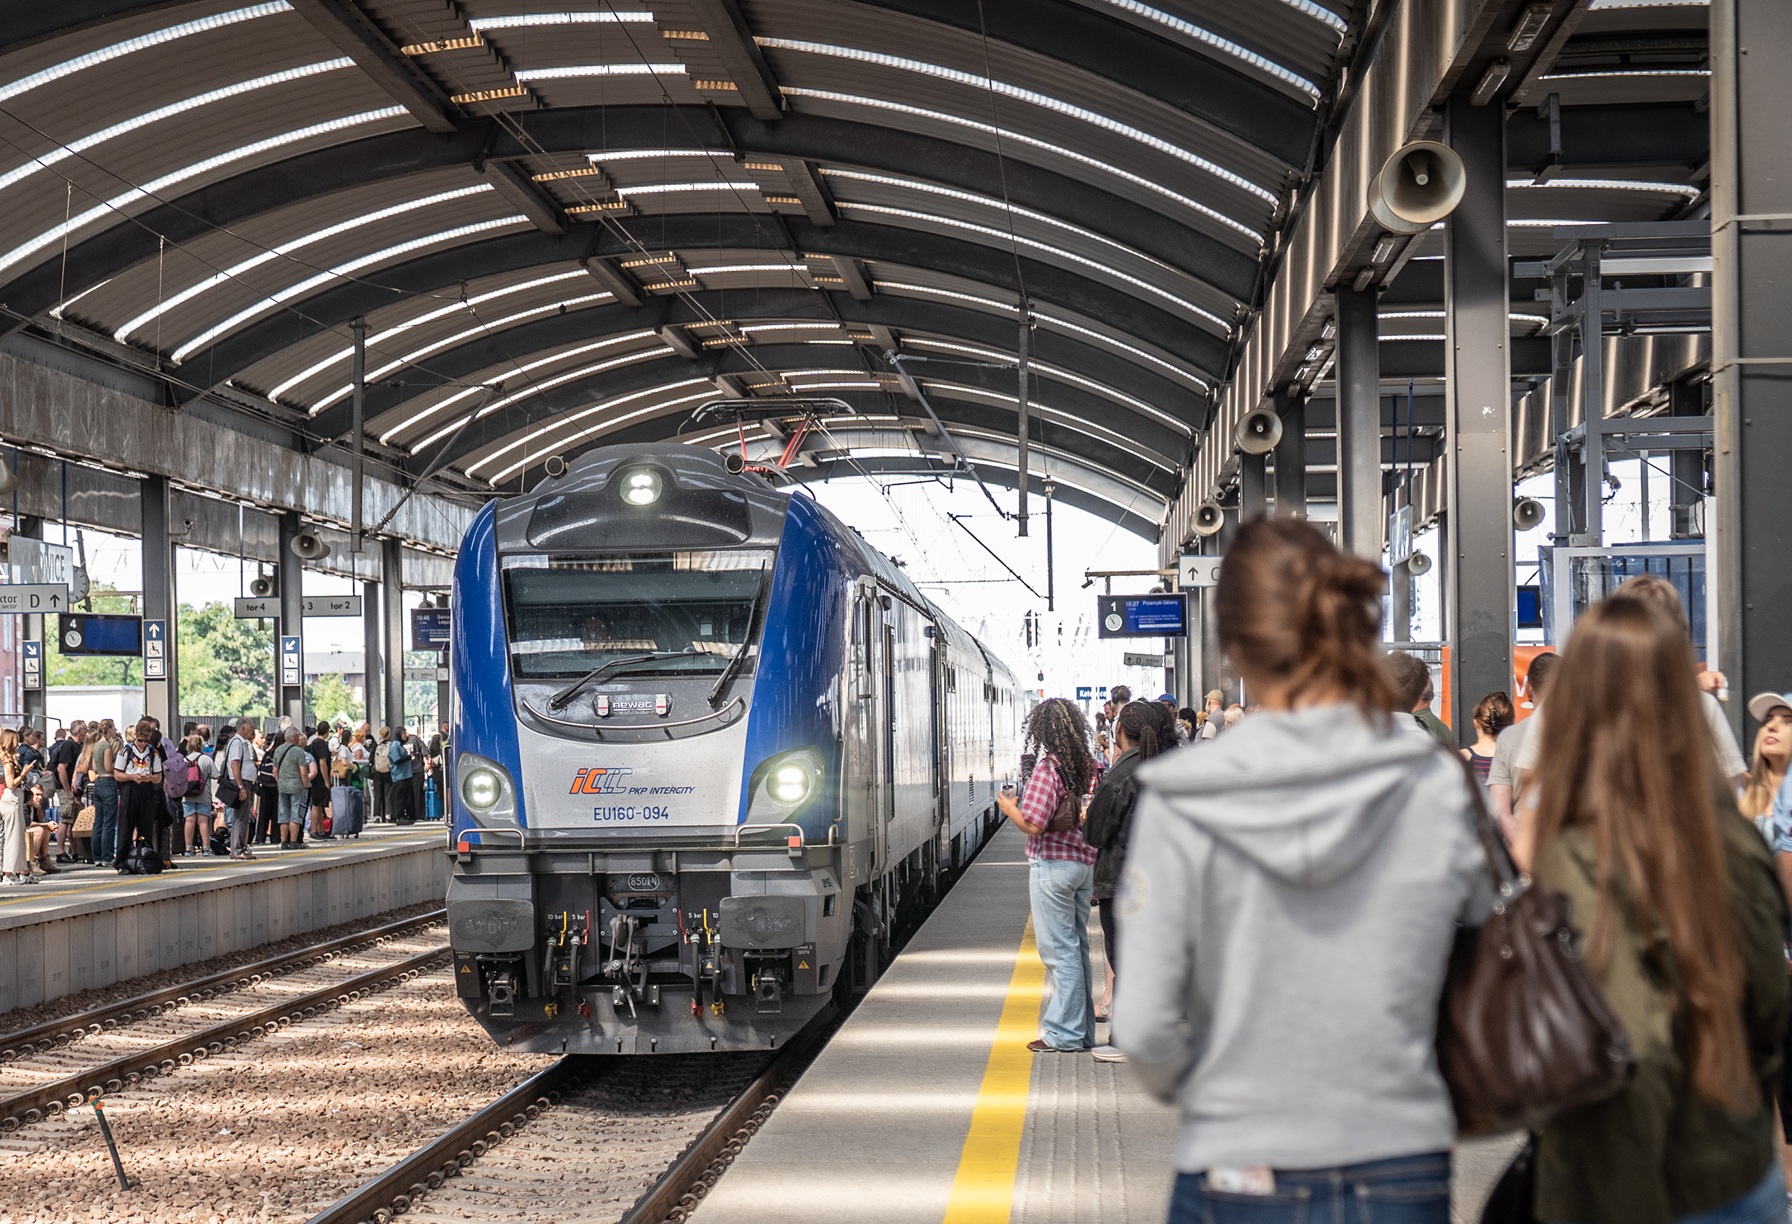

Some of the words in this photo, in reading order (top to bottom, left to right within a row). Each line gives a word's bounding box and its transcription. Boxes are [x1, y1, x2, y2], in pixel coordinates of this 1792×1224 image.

[30, 593, 40, 609] D
[307, 601, 314, 611] 3
[330, 602, 343, 610] tor
[344, 601, 351, 610] 2
[246, 603, 258, 612] tor
[259, 602, 266, 611] 4
[1110, 601, 1117, 612] 1
[69, 618, 78, 629] 4
[628, 787, 648, 795] PKP
[649, 786, 696, 795] INTERCITY
[593, 806, 670, 821] EU160-094
